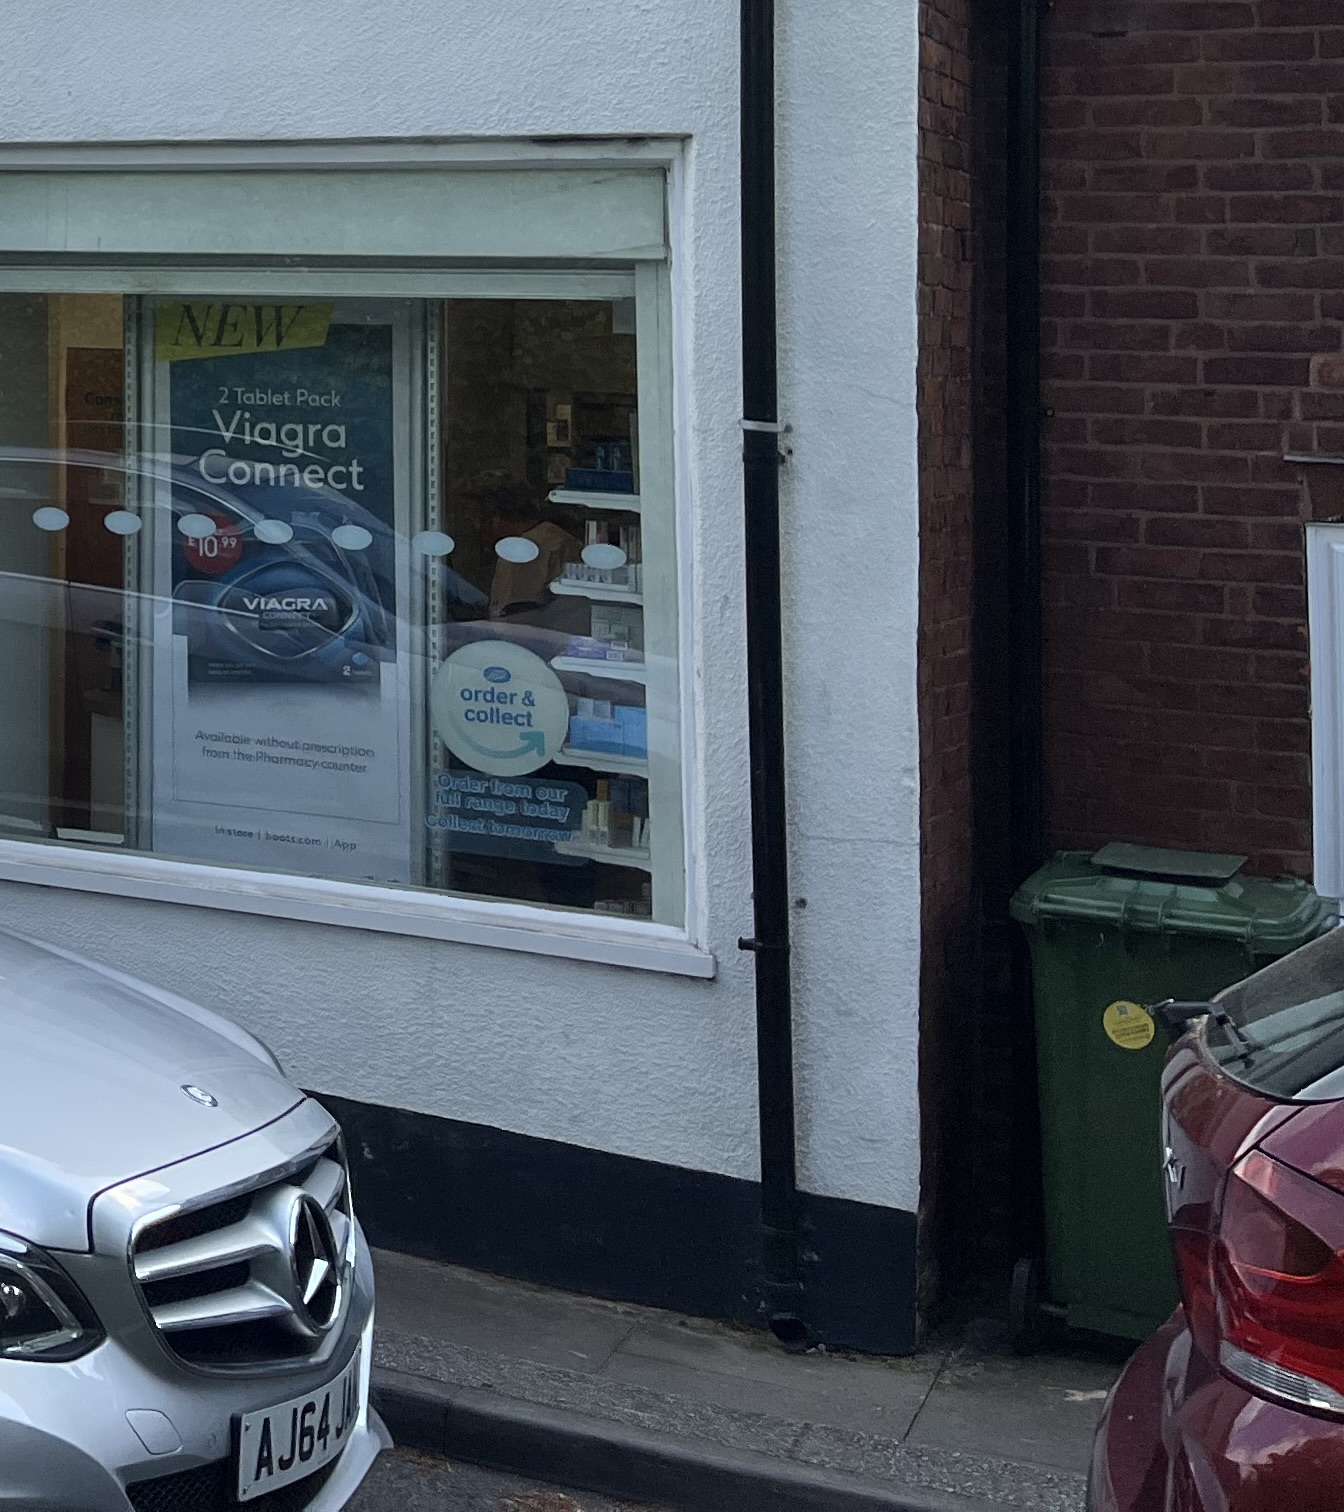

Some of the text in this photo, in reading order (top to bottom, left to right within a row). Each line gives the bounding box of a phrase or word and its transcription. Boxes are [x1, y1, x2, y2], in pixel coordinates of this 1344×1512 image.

[171, 303, 305, 348] NEW
[218, 387, 341, 407] 2 Tablet Pack
[212, 409, 346, 458] Viagra
[199, 448, 365, 490] Connect
[242, 597, 328, 611] VIAGRA
[460, 687, 536, 707] order &
[464, 706, 533, 727] collect
[195, 730, 375, 758] Available without prescription
[202, 745, 367, 773] from the Pharmacy counter
[437, 774, 568, 802] Order from our
[435, 789, 571, 823] full range today
[265, 830, 322, 846] boots.com
[334, 838, 357, 852] App
[426, 813, 573, 842] Collect tomorrow
[254, 1391, 331, 1481] AJ64
